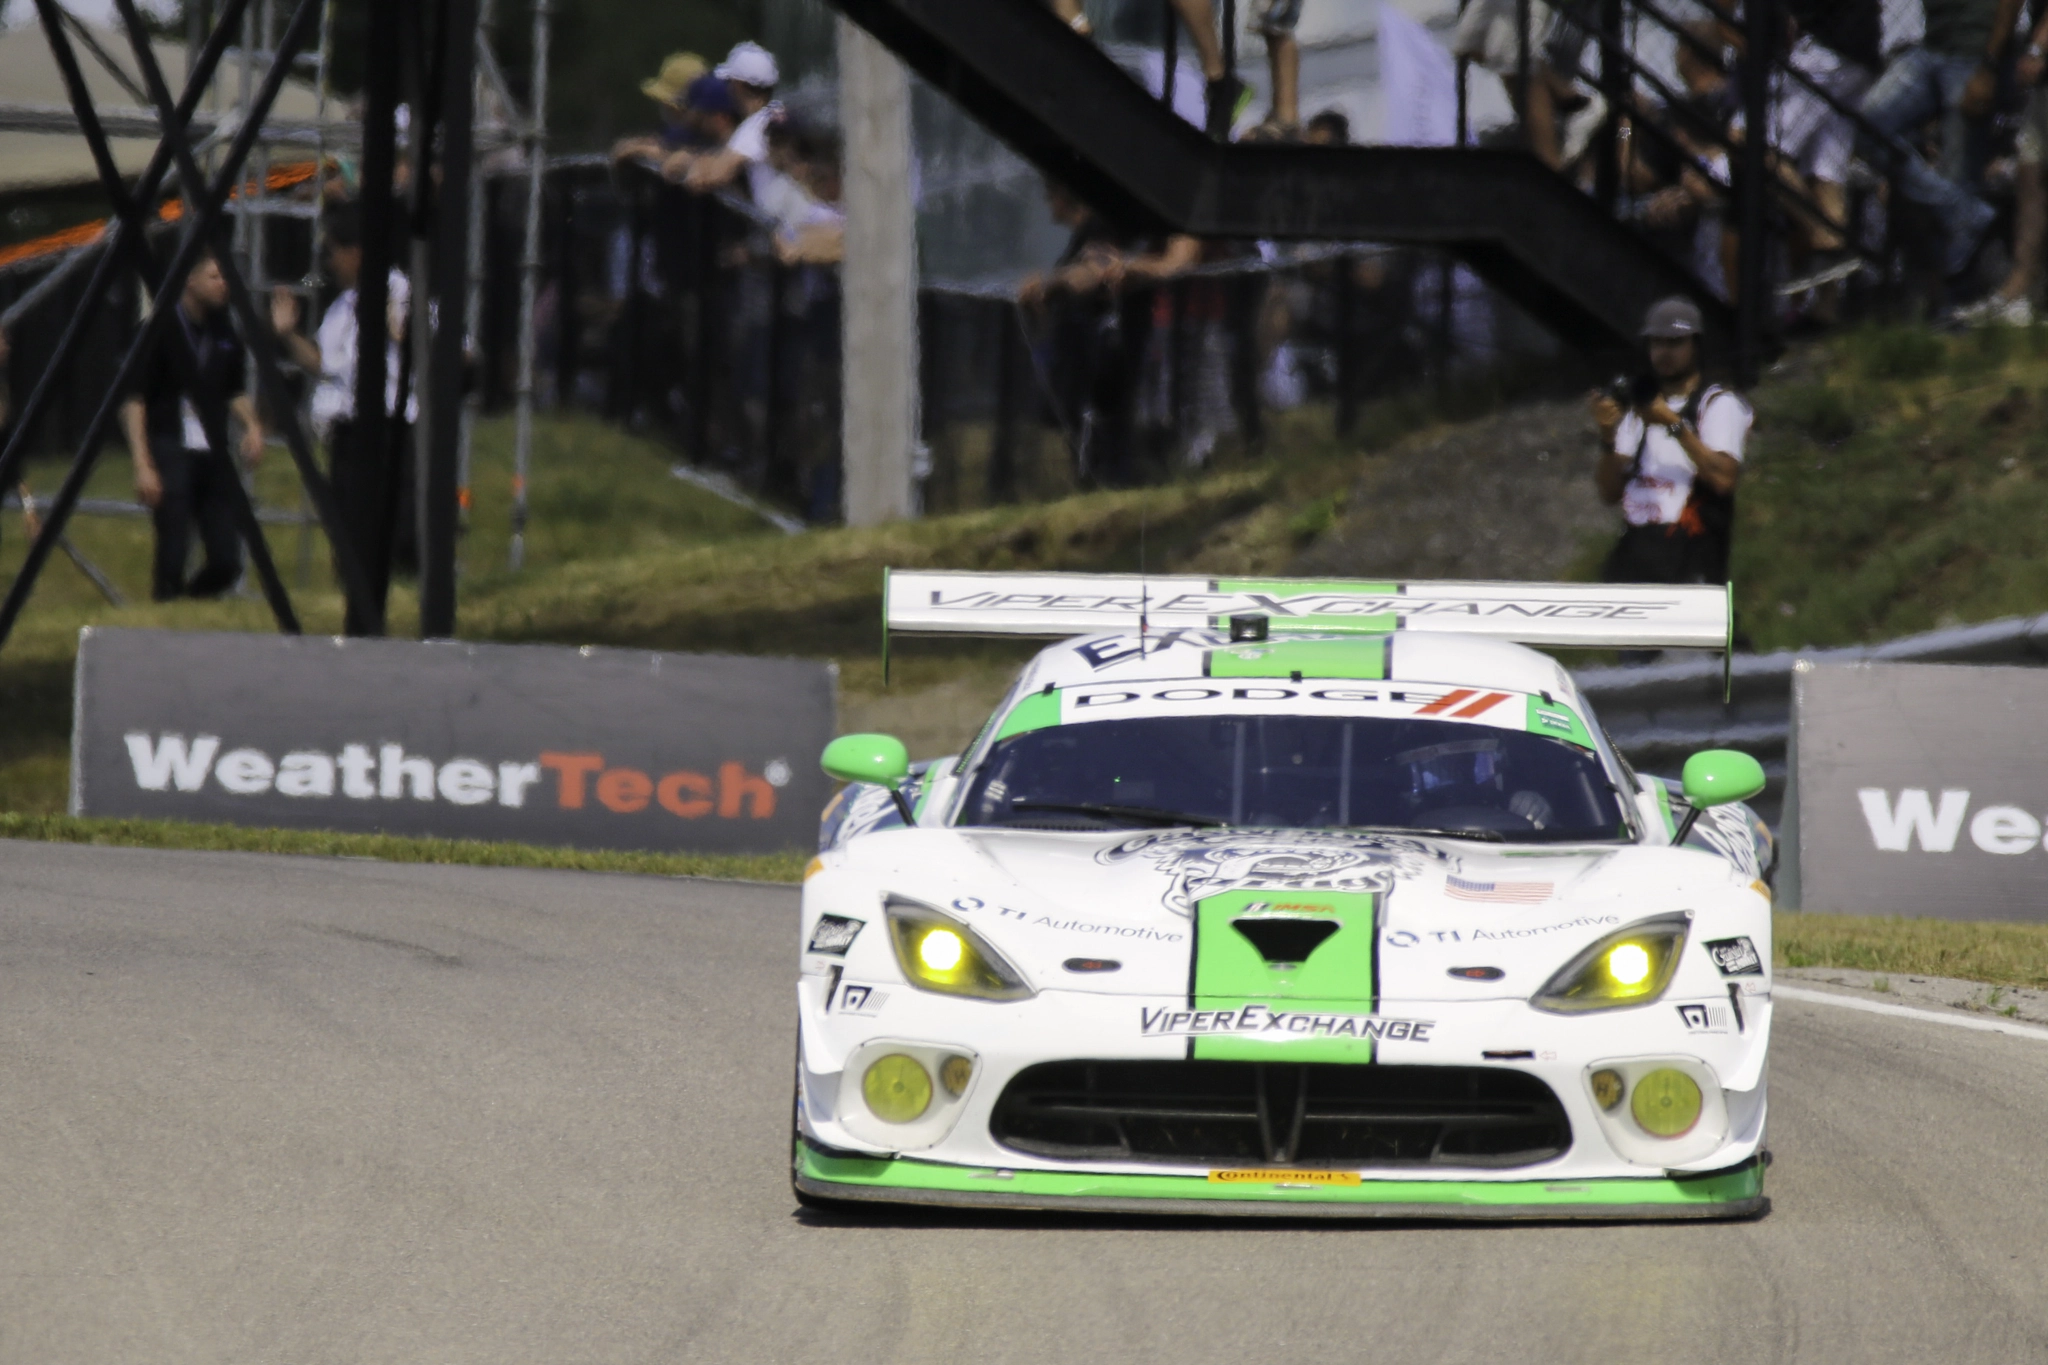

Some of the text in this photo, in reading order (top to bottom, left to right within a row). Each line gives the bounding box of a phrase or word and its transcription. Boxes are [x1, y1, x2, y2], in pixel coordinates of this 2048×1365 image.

[1075, 687, 1441, 708] DODGE
[124, 731, 775, 819] WeatherTech
[1857, 787, 2048, 856] We
[997, 905, 1184, 943] TI Automotive
[1427, 914, 1621, 943] TI Automotive
[1216, 1170, 1333, 1182] Continental
